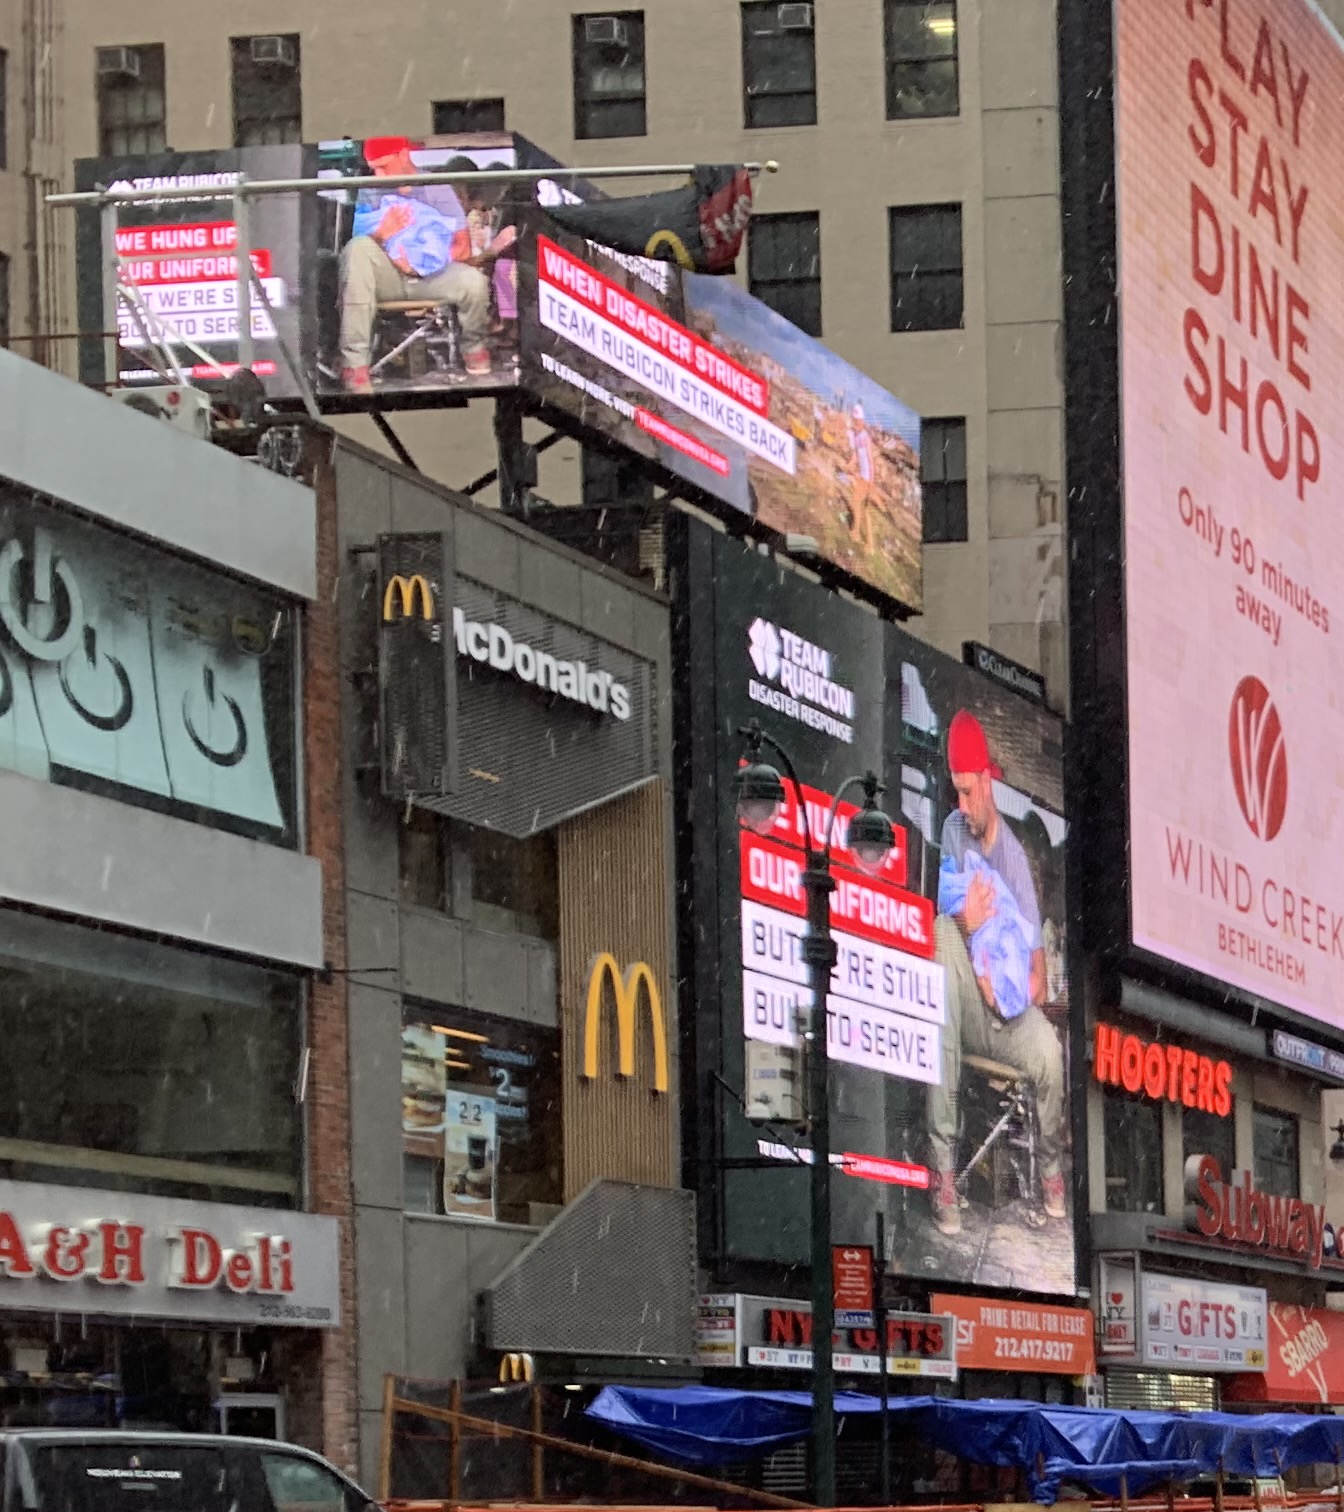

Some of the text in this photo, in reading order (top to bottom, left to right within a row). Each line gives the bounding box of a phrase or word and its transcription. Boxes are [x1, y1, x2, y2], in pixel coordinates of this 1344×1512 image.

[1187, 0, 1310, 147] LAY
[1187, 57, 1310, 264] STAY
[115, 231, 146, 251] WE
[151, 227, 207, 249] HUNG
[159, 288, 218, 309] WE'RE
[203, 314, 269, 335] SERE.
[544, 246, 764, 409] WHEN DISASTER STRIKES
[1190, 182, 1312, 392] DINE
[545, 295, 596, 346] TEAM
[601, 330, 677, 394] RUBICON
[679, 379, 745, 435] STRIKES
[748, 424, 788, 464] BACK
[1183, 308, 1321, 501] SHOP
[1178, 487, 1330, 635] Only 90 minutes
[779, 626, 832, 679] TEAM
[1235, 584, 1282, 647] away
[748, 678, 854, 745] DISASTER RESPONSE
[780, 656, 855, 721] RUBICON
[750, 848, 928, 944] OUR NIFORMS.
[1165, 826, 1254, 914] WIND
[752, 919, 799, 967] BUT
[882, 962, 939, 1010] STILL
[1218, 923, 1307, 986] BETHLEHEM
[859, 1019, 934, 1071] SERVE.
[1095, 1022, 1233, 1118] HOOTERS
[0, 1211, 295, 1292] A&H Deli
[1194, 1154, 1326, 1270] Subway
[853, 1317, 944, 1354] GFTS
[980, 1306, 1009, 1330] PRIME
[1010, 1309, 1041, 1332] RETAIL
[1042, 1312, 1059, 1333] FOR
[1060, 1313, 1087, 1336] LEASE
[1279, 1319, 1329, 1377] SBARRO
